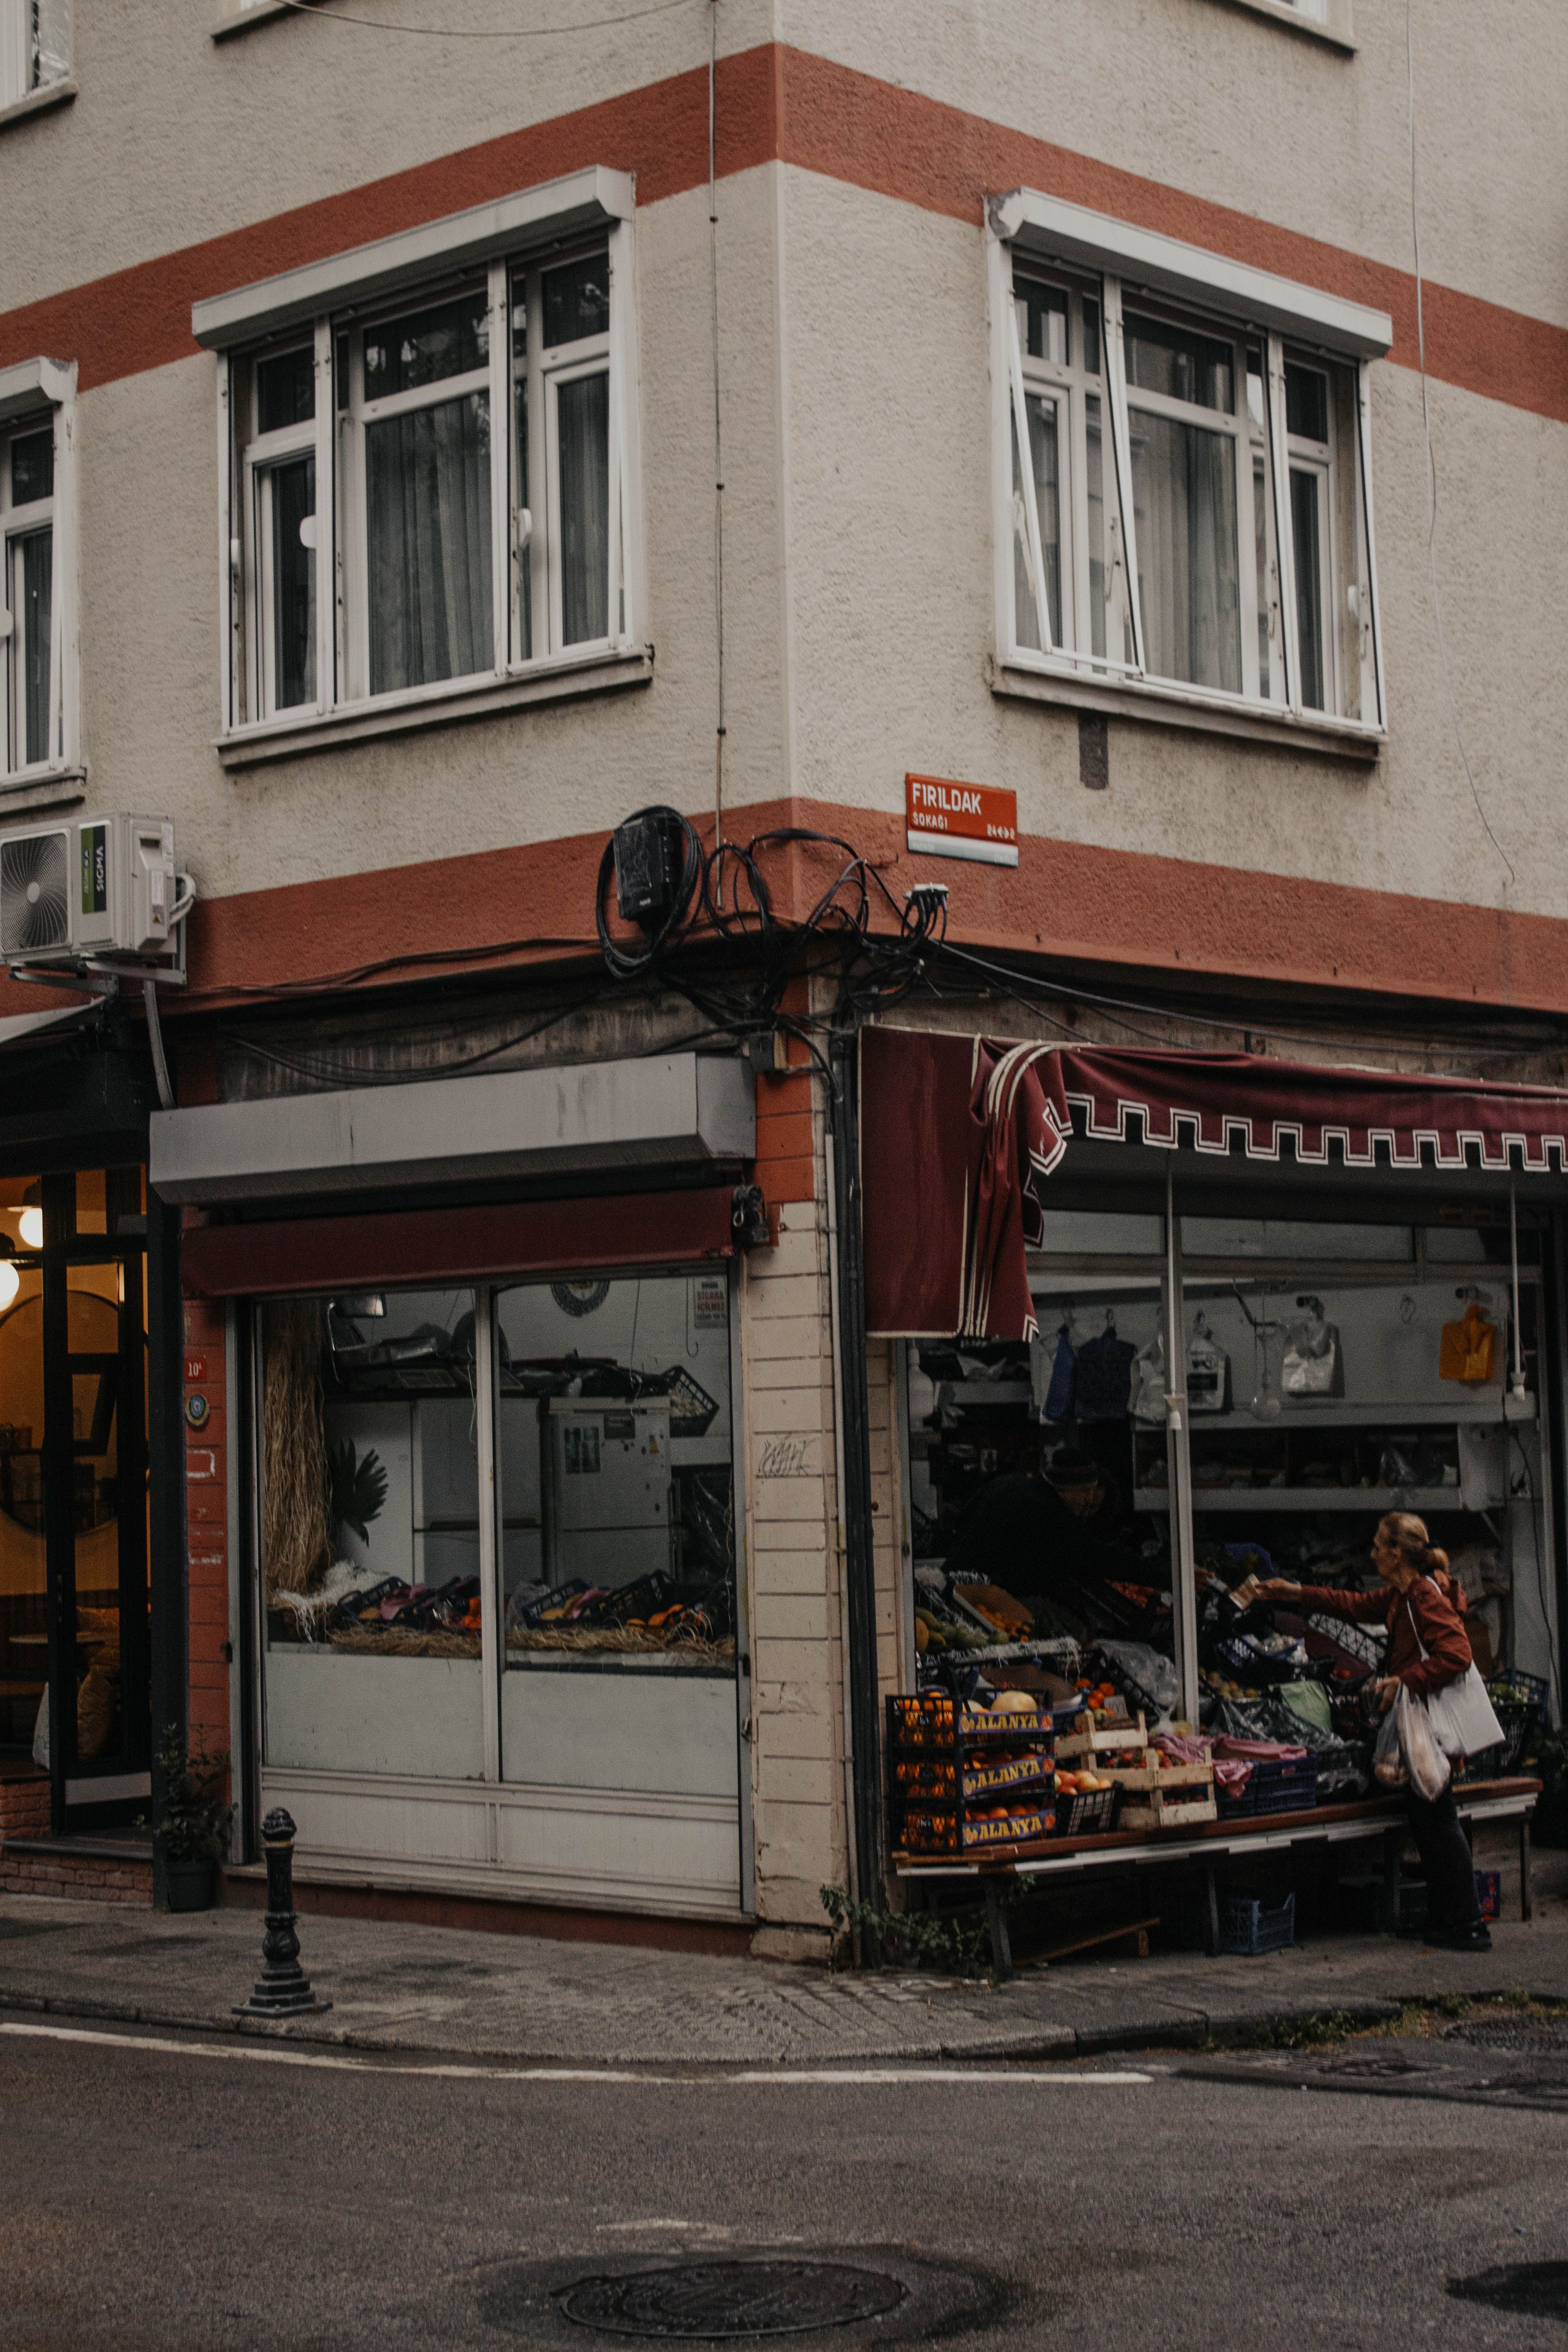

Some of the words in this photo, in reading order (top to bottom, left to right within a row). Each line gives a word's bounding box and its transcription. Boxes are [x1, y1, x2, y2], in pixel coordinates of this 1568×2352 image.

[912, 782, 982, 816] FIRILDAK
[96, 844, 104, 892] SIGMA
[975, 1713, 1039, 1730] ALANYA
[977, 1759, 1041, 1789] ALANYA
[979, 1815, 1043, 1841] ALANYA
